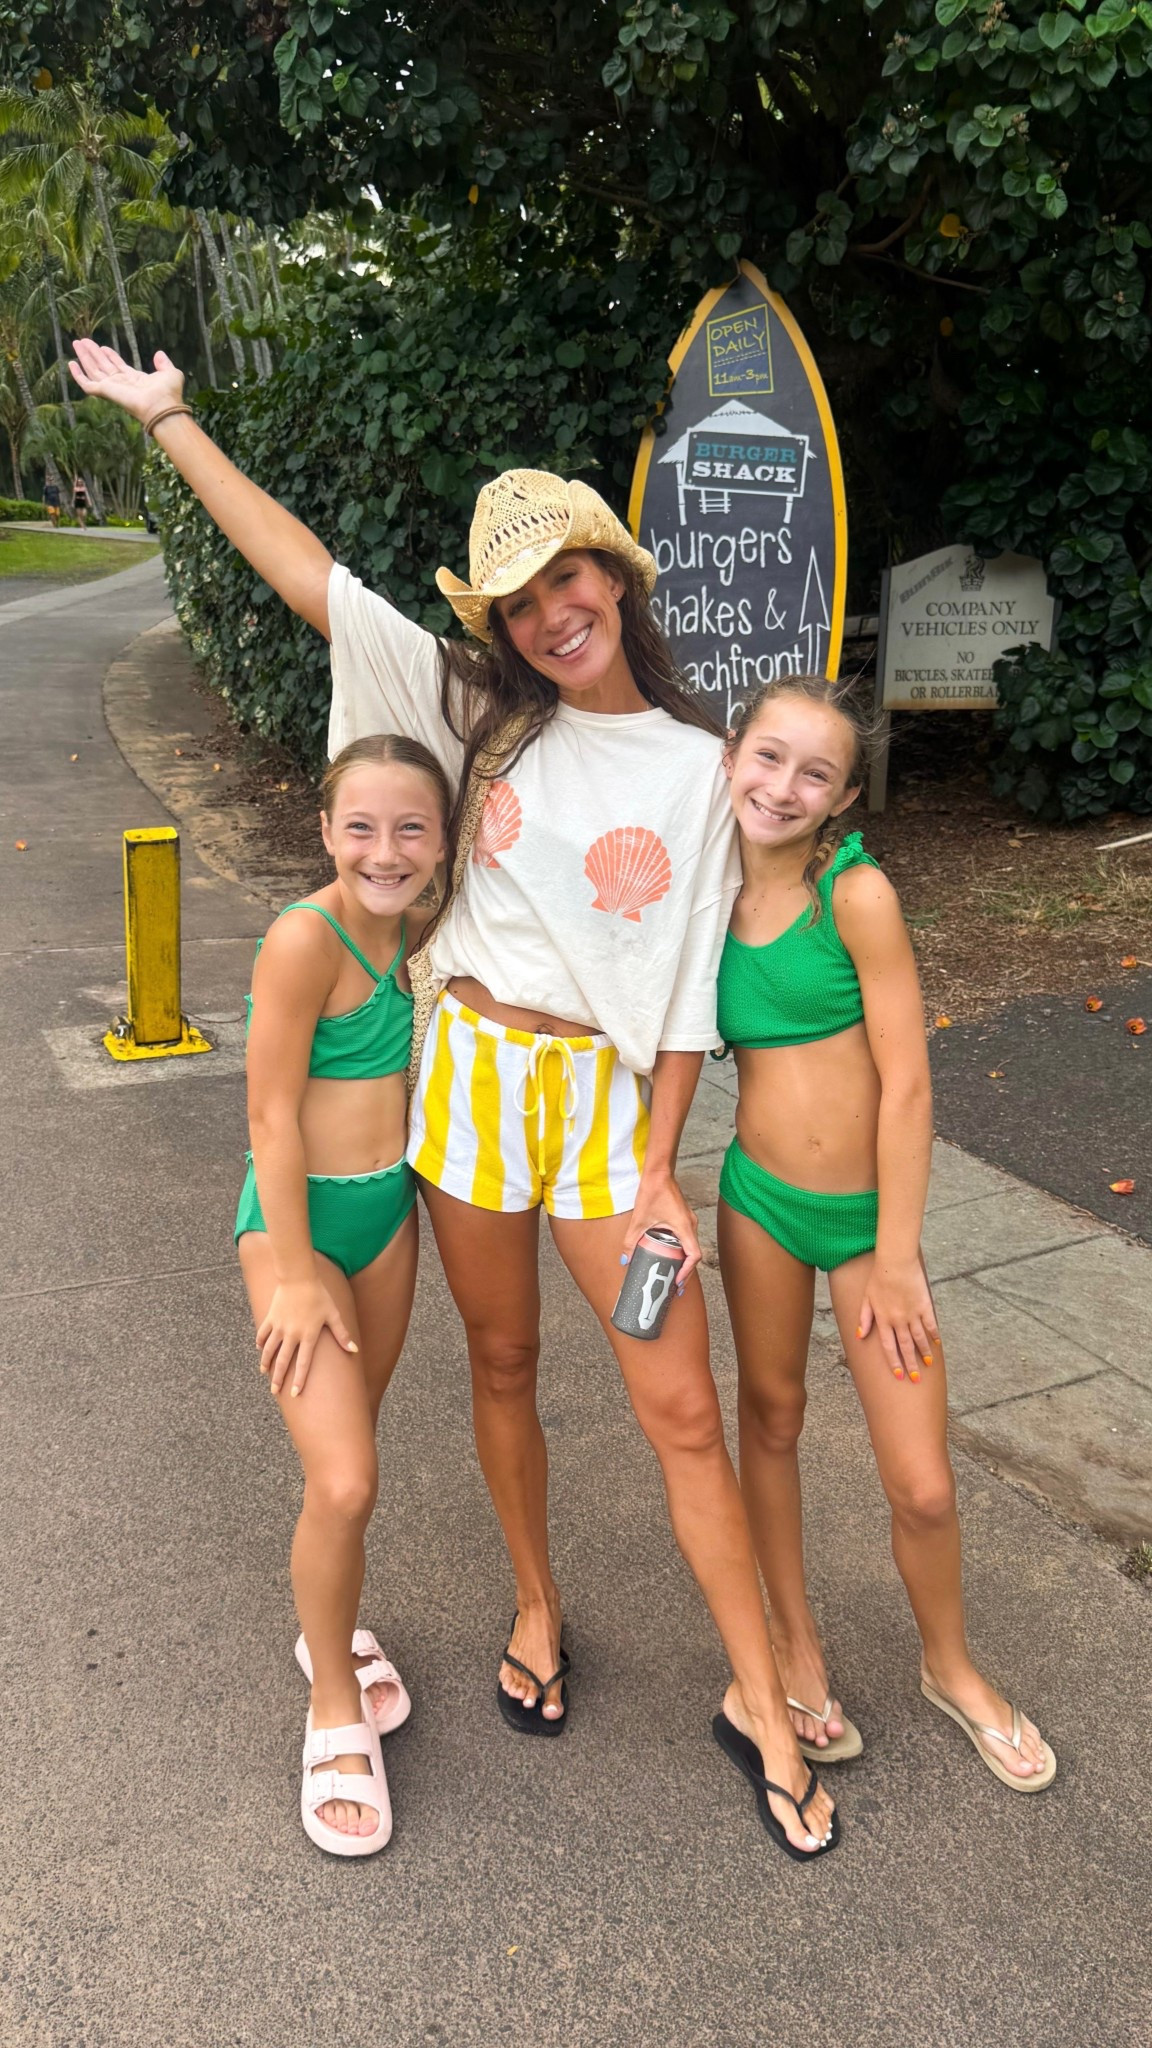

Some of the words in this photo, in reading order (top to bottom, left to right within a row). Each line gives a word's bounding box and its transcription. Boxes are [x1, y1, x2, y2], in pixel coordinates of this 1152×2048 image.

[711, 317, 757, 341] OPEN
[713, 331, 765, 357] DAILY
[695, 442, 798, 463] BURGER
[692, 461, 796, 484] SHACK
[650, 527, 793, 586] burgers
[650, 585, 752, 637] shakes
[764, 588, 787, 630] &
[925, 601, 1017, 617] COMPANY
[901, 621, 987, 637] VEHICLES
[991, 620, 1040, 636] ONLY
[680, 643, 804, 693] achfront
[956, 651, 975, 664] NO
[910, 686, 926, 699] OR
